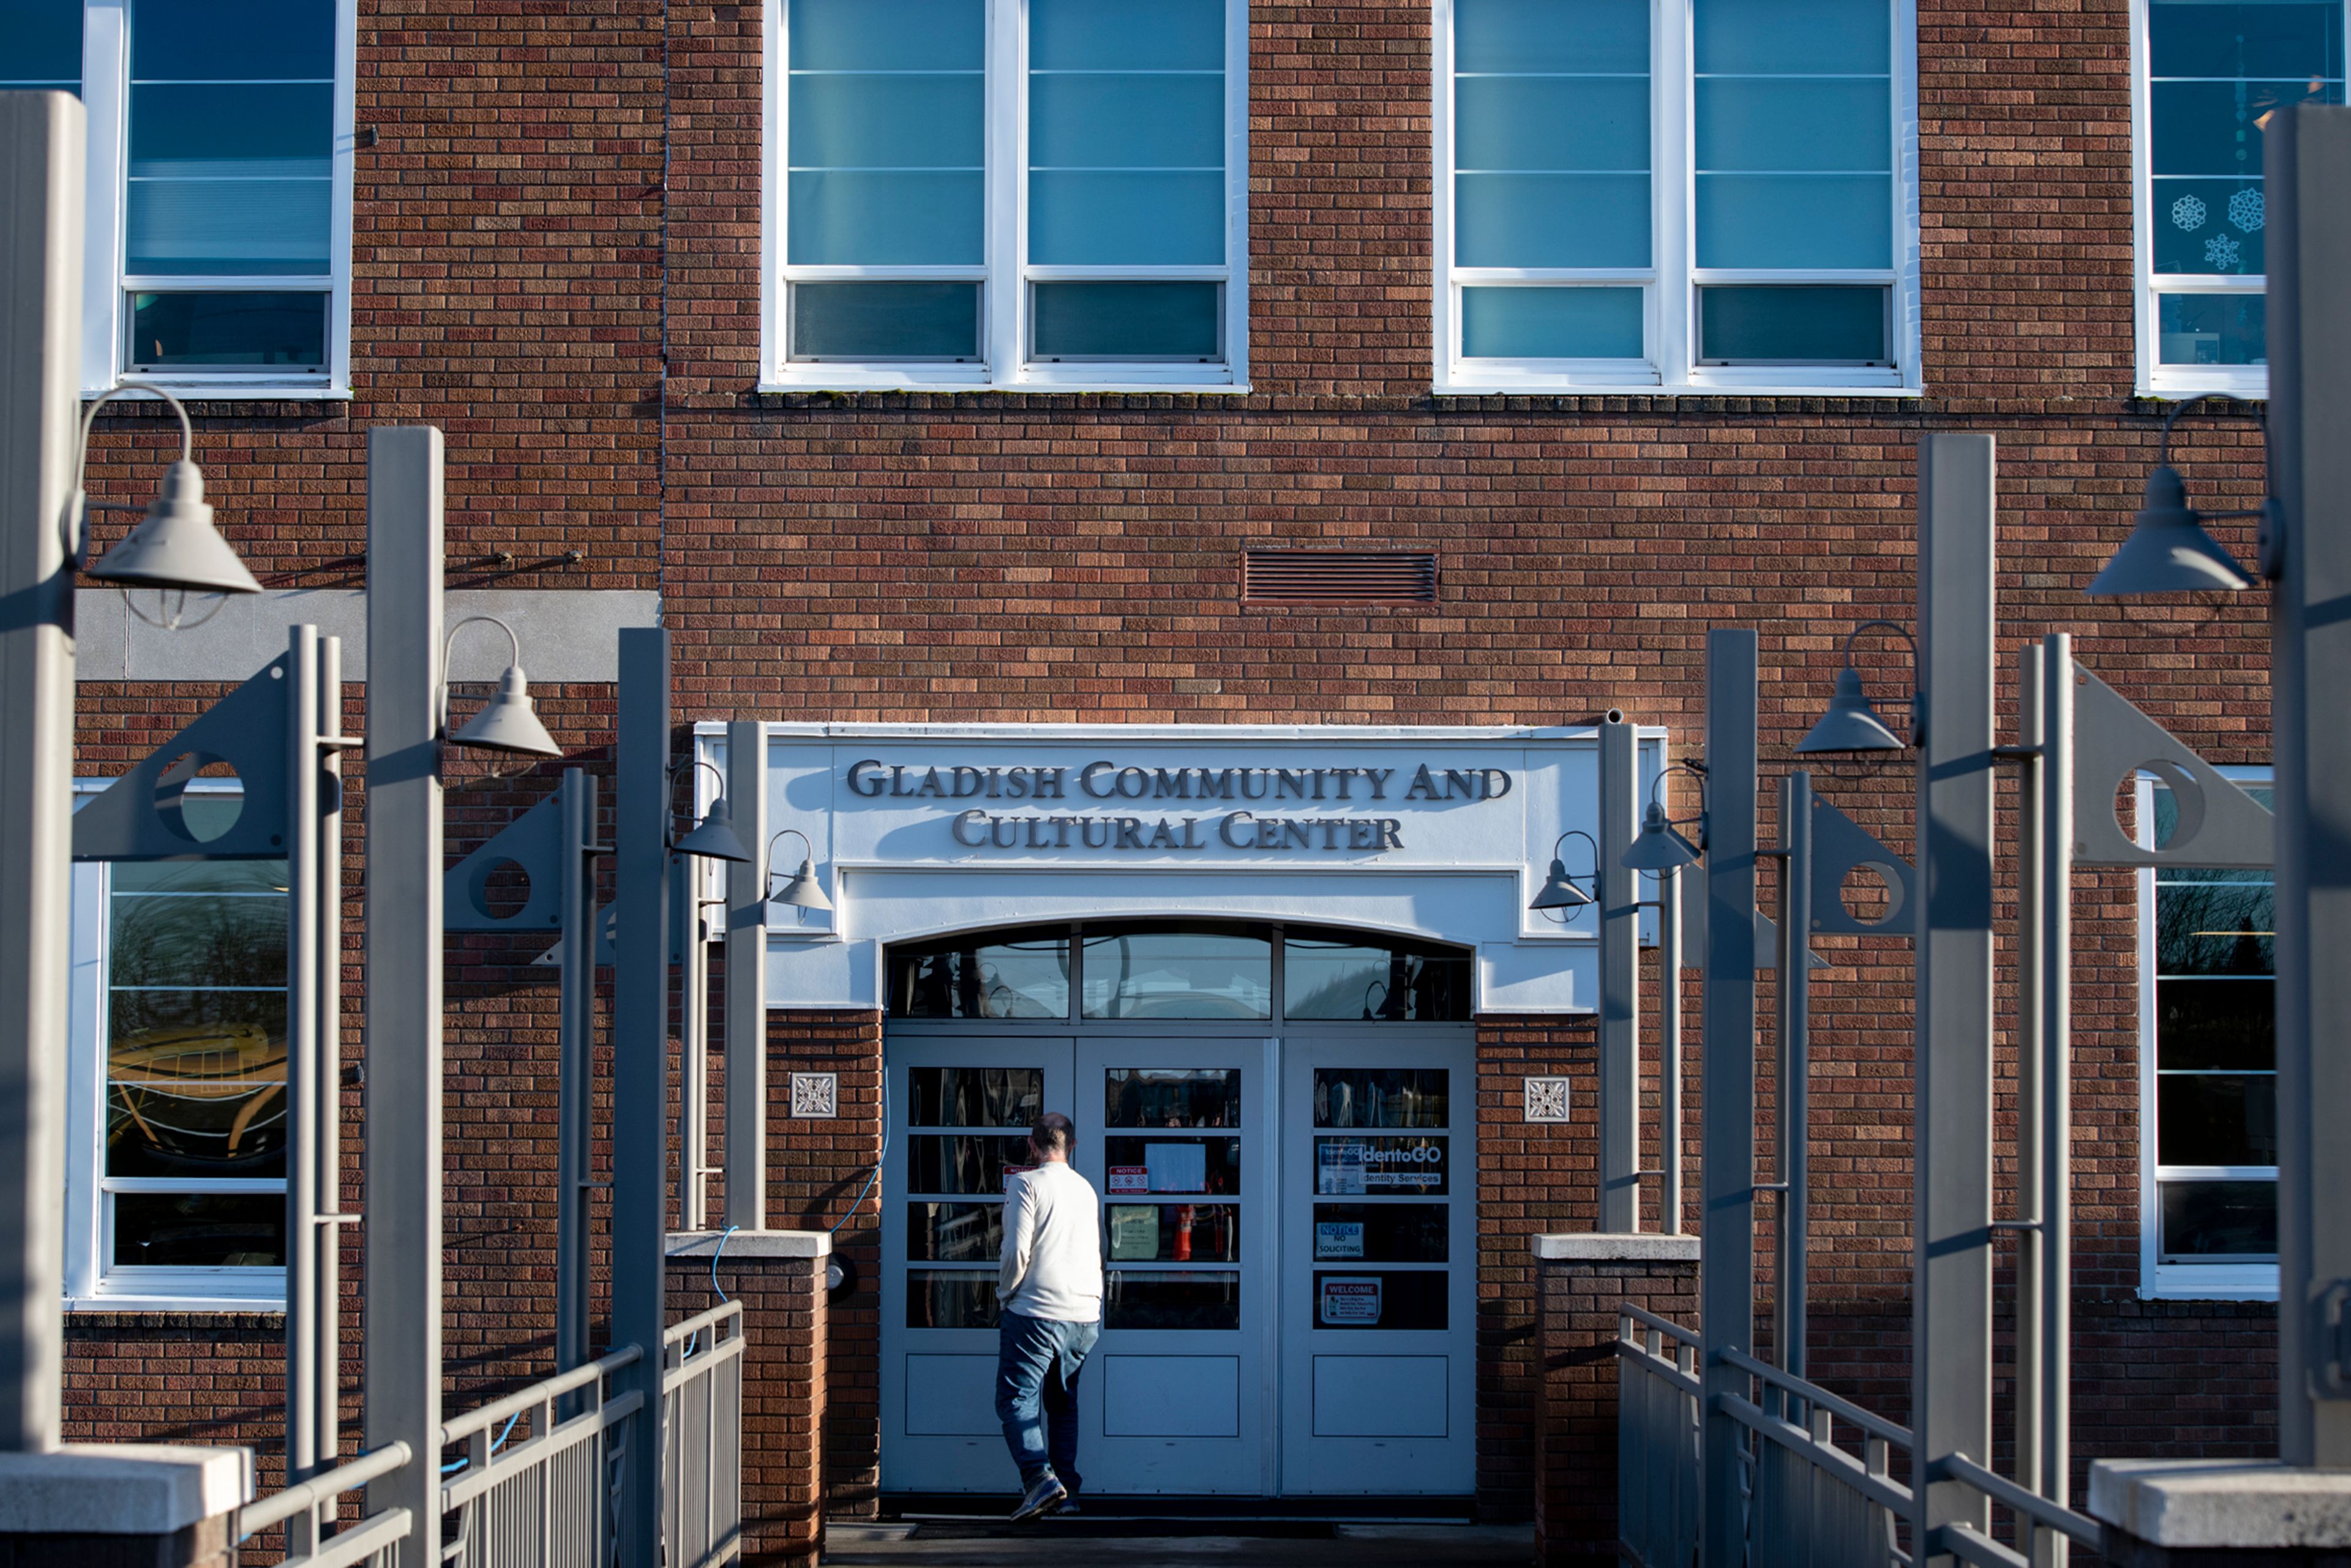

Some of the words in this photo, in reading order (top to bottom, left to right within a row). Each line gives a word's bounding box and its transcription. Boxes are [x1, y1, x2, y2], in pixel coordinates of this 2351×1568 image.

[847, 759, 1067, 798] GLADISH
[1081, 761, 1395, 799] COMMUNITY
[1404, 763, 1512, 800] AND
[952, 809, 1205, 849] CULTURAL
[1219, 811, 1404, 850] CENTER
[1359, 1146, 1441, 1163] IdentoGO
[1322, 1225, 1357, 1234] NOTICE
